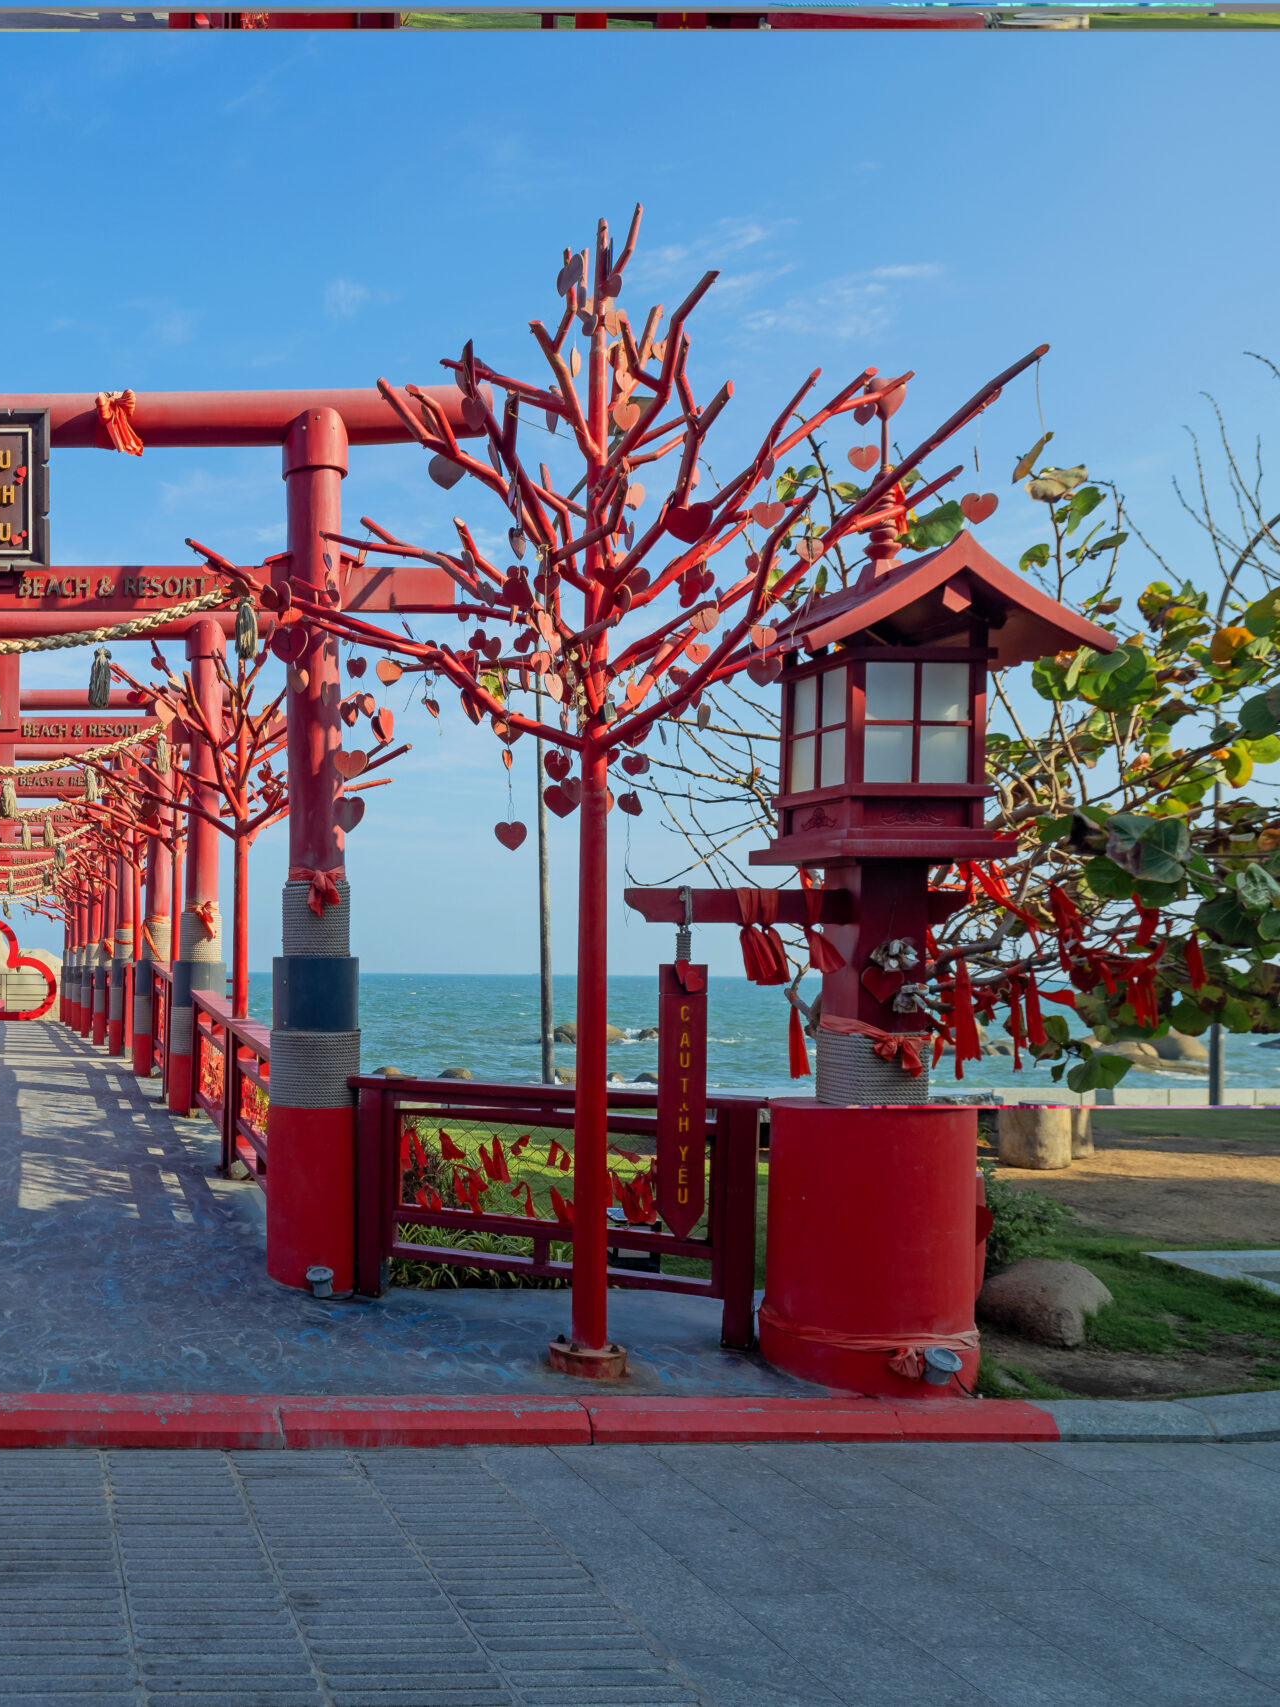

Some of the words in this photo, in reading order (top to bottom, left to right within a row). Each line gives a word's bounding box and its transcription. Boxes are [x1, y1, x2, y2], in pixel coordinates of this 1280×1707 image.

[19, 575, 91, 598] BEACH
[99, 576, 115, 597] &
[124, 575, 210, 597] RESORT
[22, 722, 69, 737] BEACH
[73, 723, 83, 737] &
[87, 722, 143, 737] RESORT
